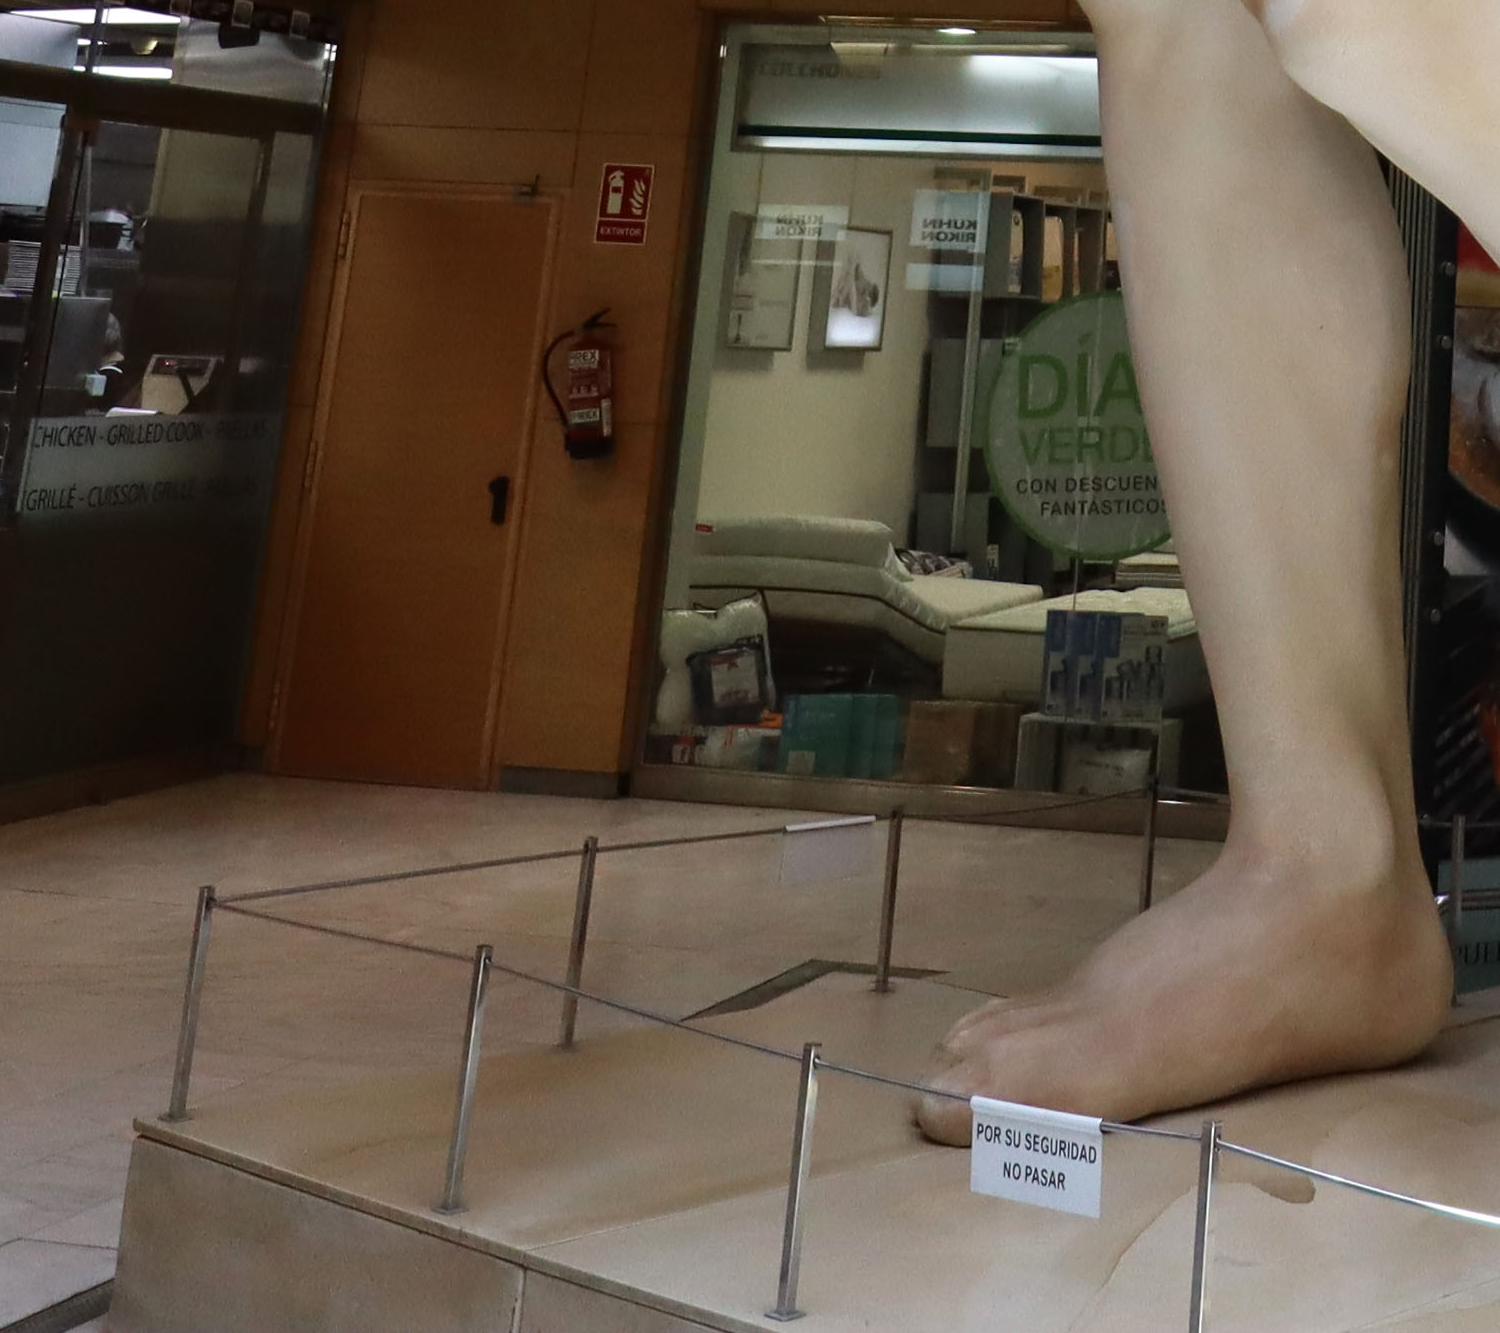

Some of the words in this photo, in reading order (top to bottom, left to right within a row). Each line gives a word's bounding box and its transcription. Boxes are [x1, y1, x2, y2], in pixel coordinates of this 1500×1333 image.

[599, 226, 644, 238] EXTINTOR
[1018, 334, 1143, 419] DÍA
[107, 423, 163, 446] GRILLED
[1016, 478, 1057, 494] CON
[976, 1122, 1002, 1144] POR
[1005, 1128, 1022, 1148] SU
[1024, 1133, 1097, 1164] SEGURIDAD
[1002, 1161, 1022, 1181] NO
[1024, 1165, 1067, 1190] PASAR
